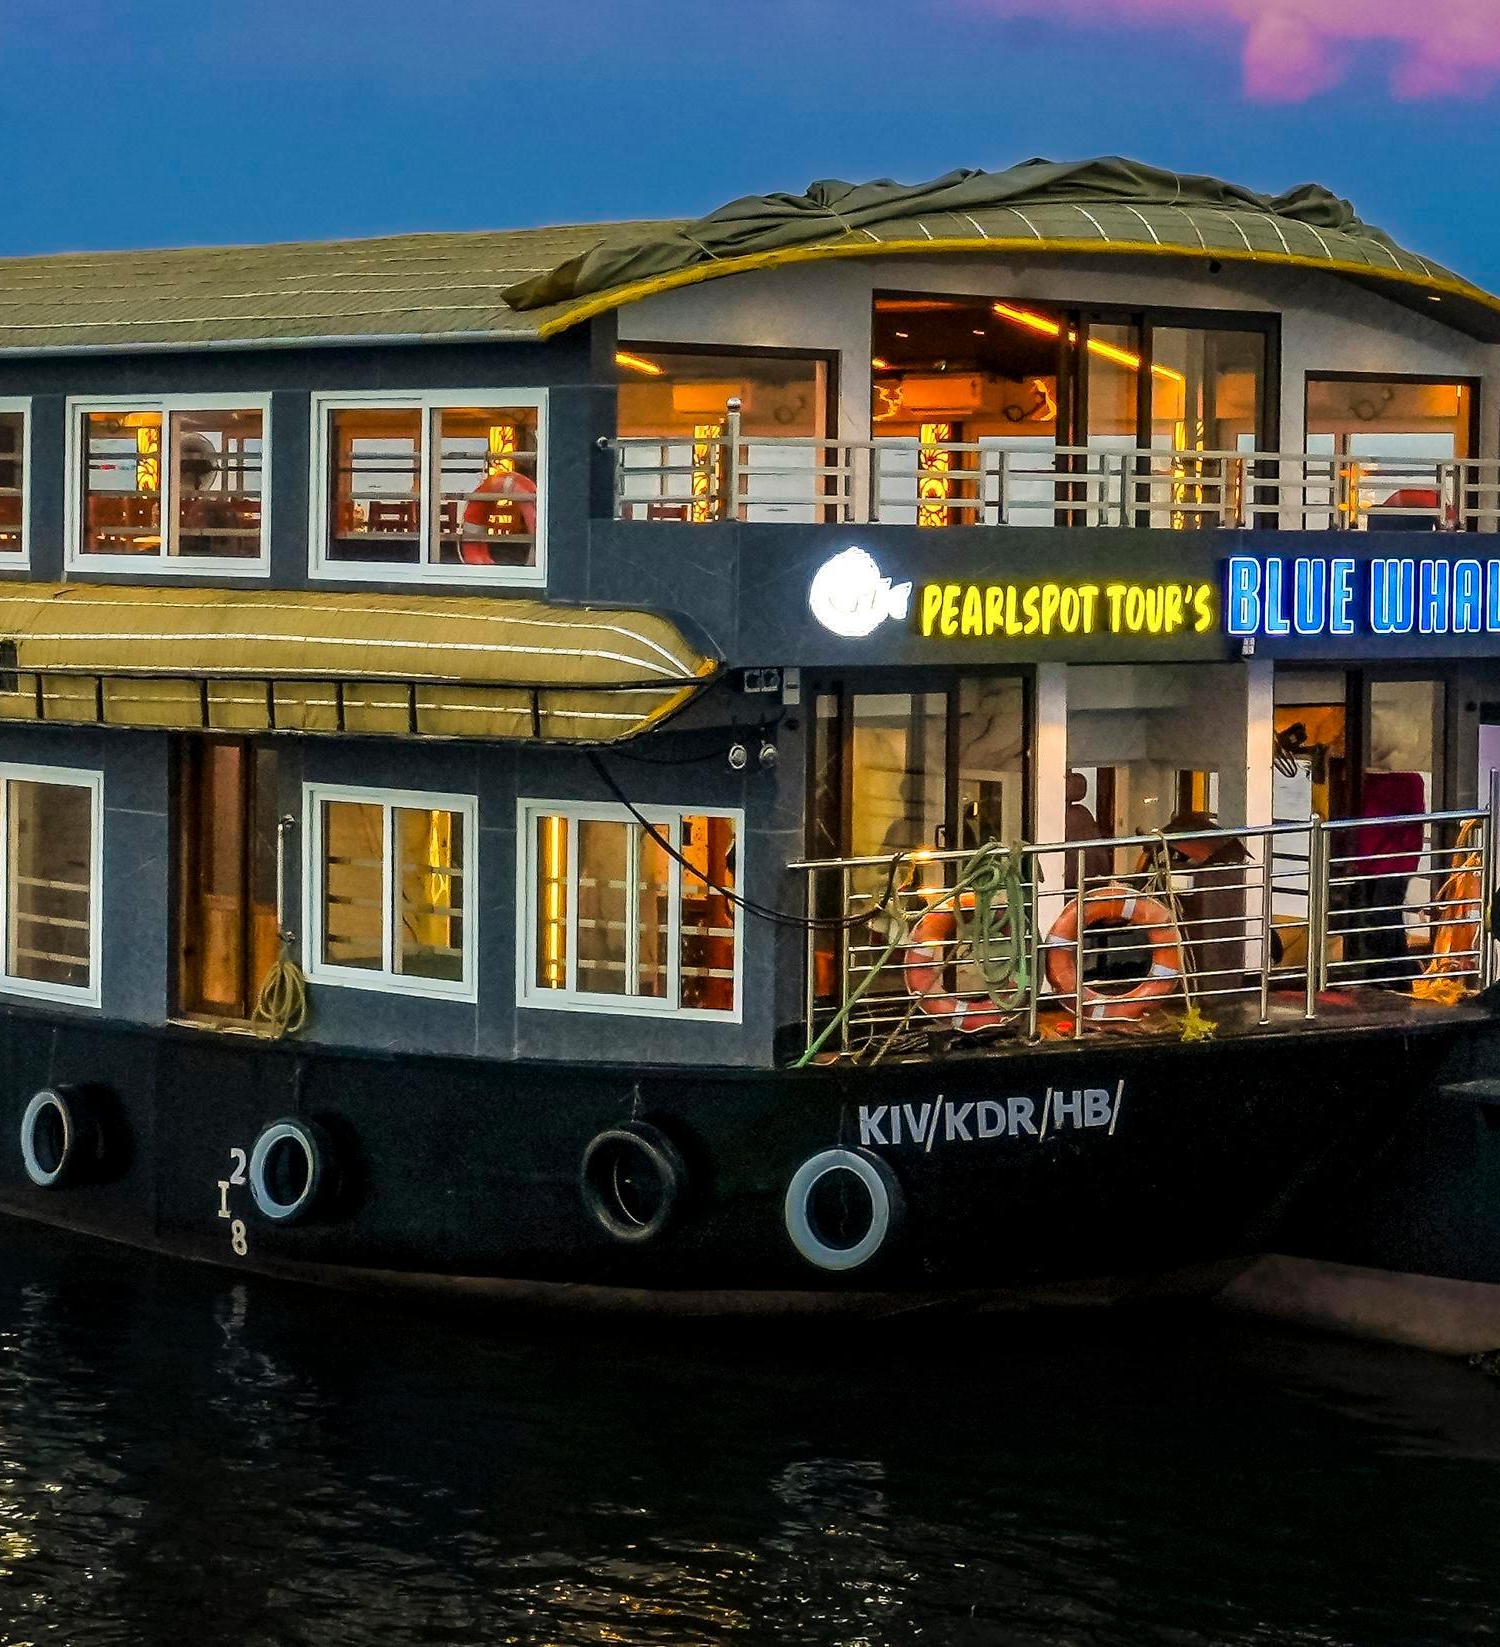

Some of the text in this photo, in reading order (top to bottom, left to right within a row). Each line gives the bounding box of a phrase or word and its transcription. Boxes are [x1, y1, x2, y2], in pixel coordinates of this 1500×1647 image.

[921, 583, 1100, 637] PEARLSPOT
[1106, 583, 1212, 634] TOUR'S
[1227, 556, 1355, 636] BLUE
